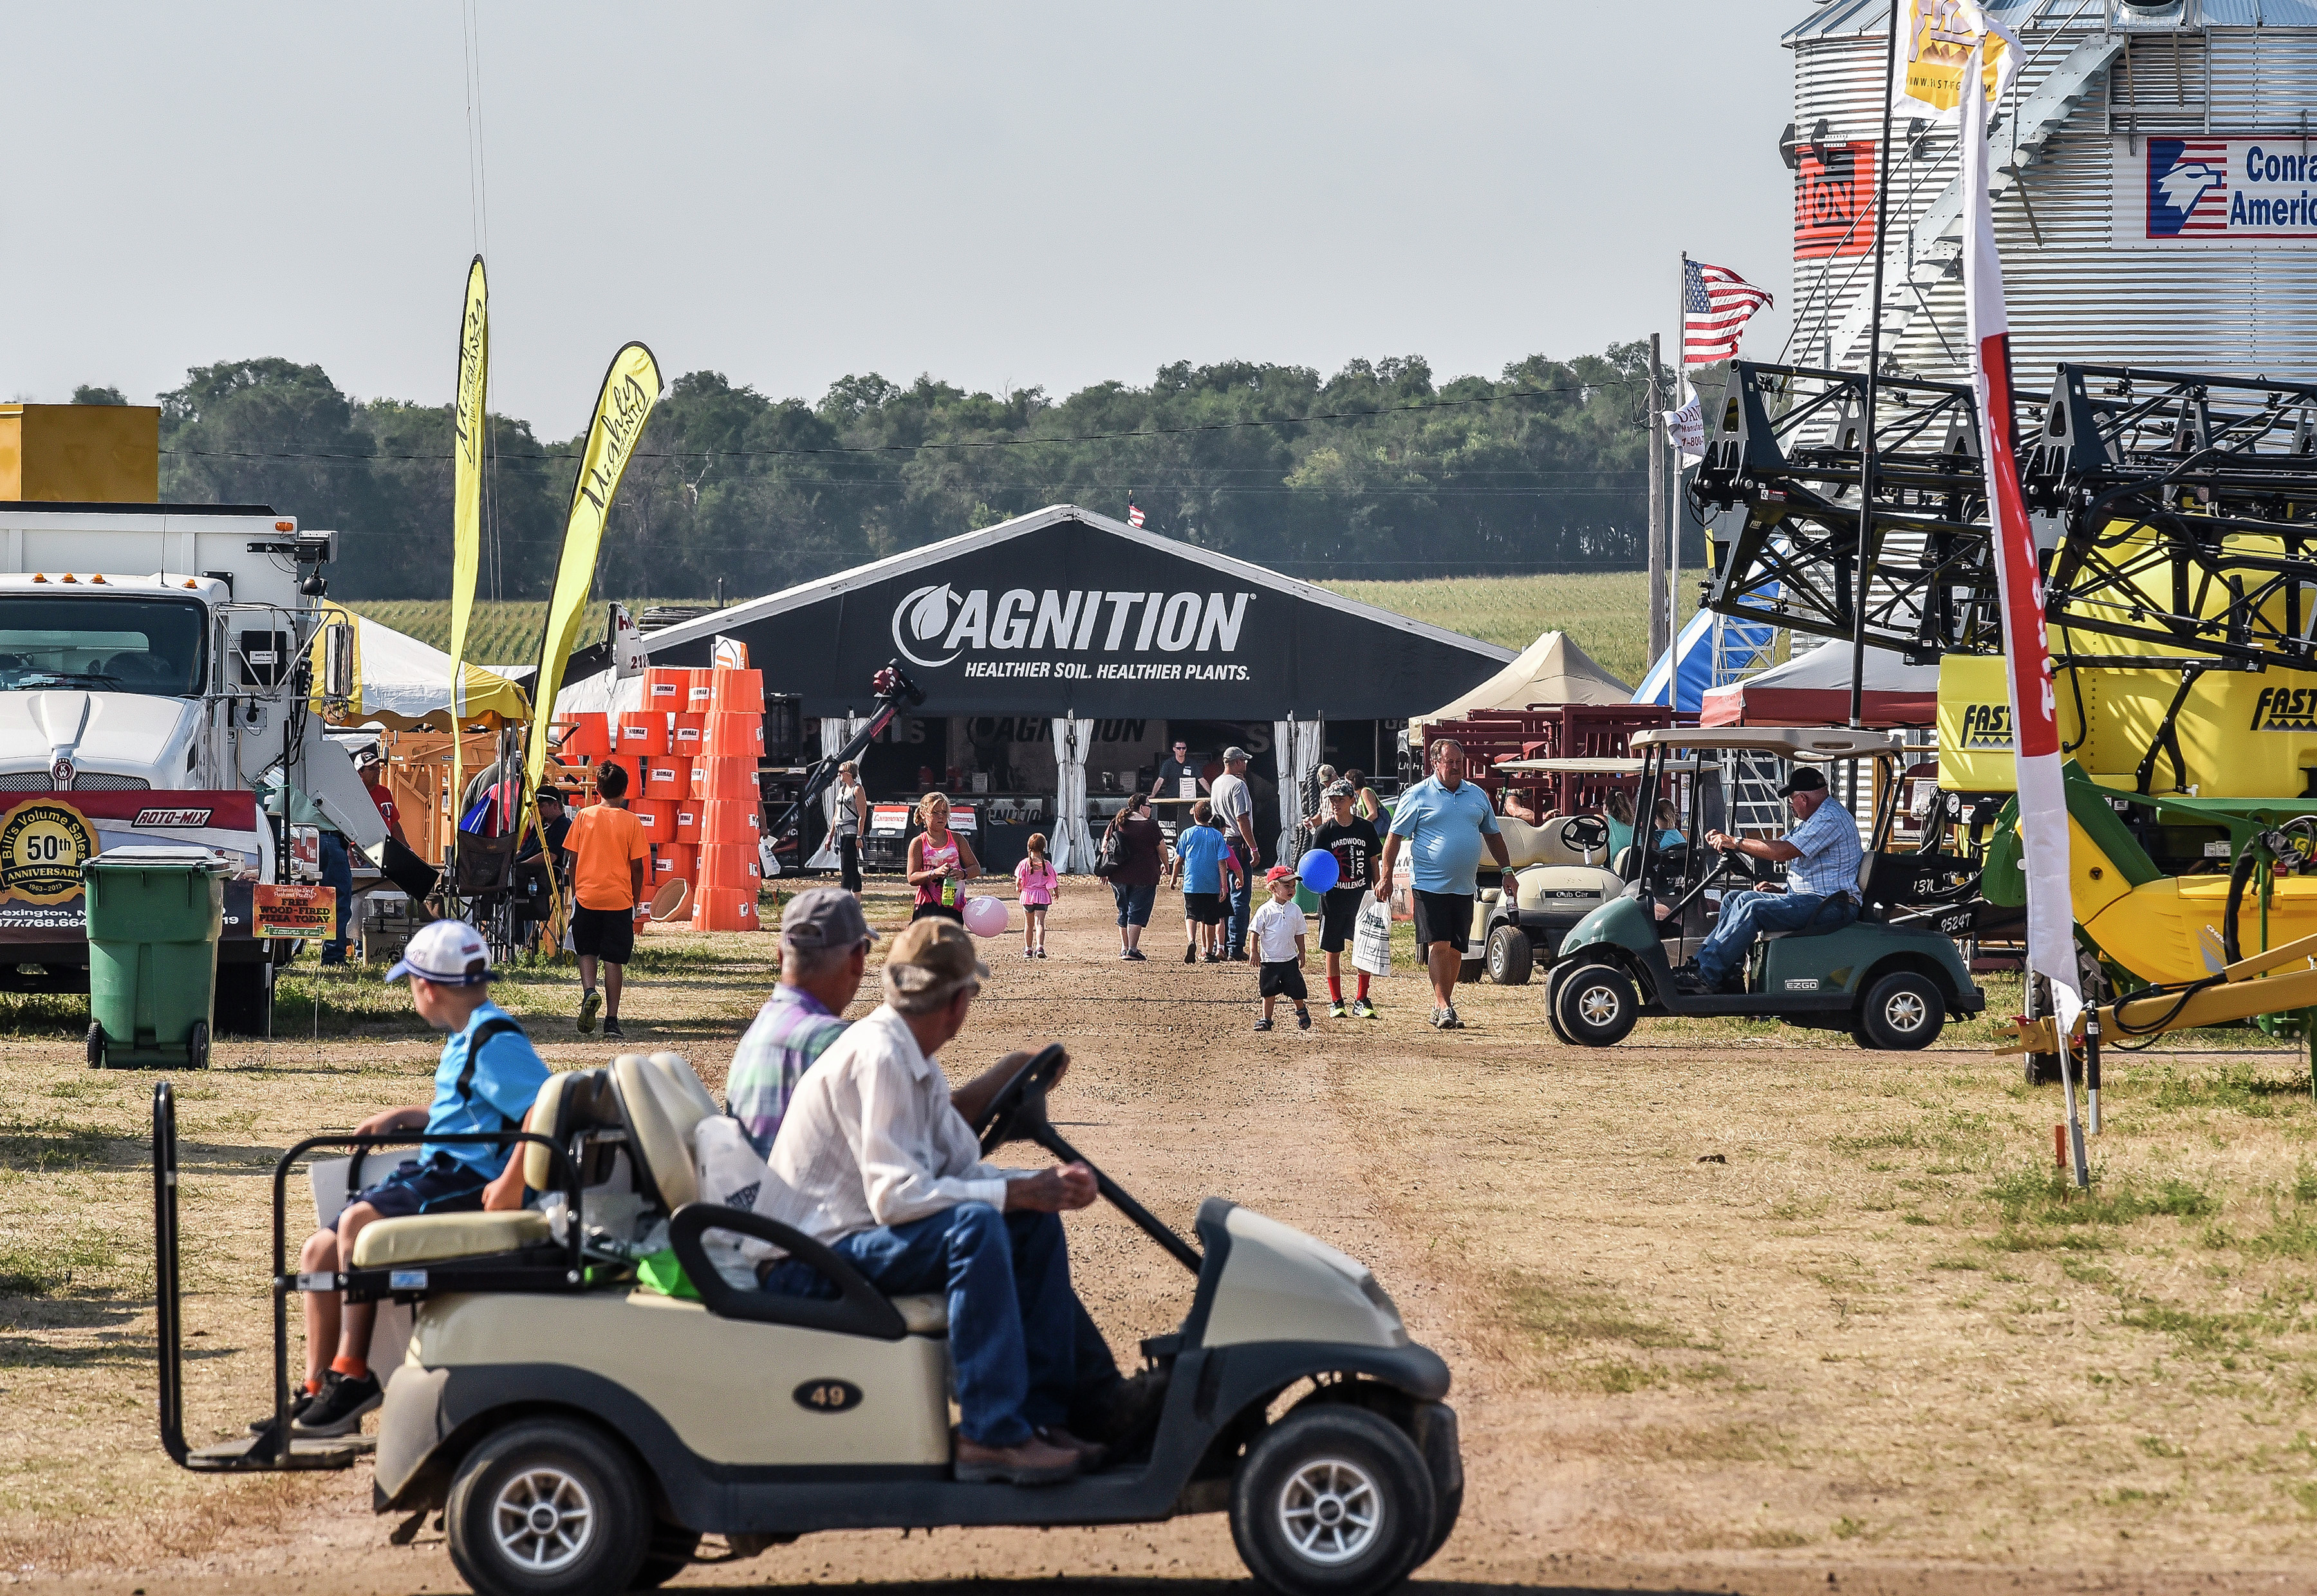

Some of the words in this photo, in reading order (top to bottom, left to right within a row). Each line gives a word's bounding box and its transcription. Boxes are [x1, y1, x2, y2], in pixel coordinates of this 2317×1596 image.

[581, 374, 646, 530] Mighty
[944, 589, 1249, 652] AGNITION
[965, 662, 1051, 678] HEALTHIER
[1054, 663, 1092, 680] SOIL.
[1097, 663, 1180, 680] HEALTHIER
[1184, 665, 1251, 681] PLANTS.
[2250, 687, 2317, 731] FAST
[136, 810, 208, 825] ROTO-MIX
[3, 826, 19, 860] Bill's
[17, 810, 68, 826] Volume
[69, 822, 86, 860] Sales
[1331, 837, 1366, 849] HARDWOOD
[27, 835, 71, 861] 50th
[1356, 849, 1364, 875] 2015
[8, 868, 81, 881] ANNIVERSARY
[0, 909, 72, 918] exington,
[259, 905, 330, 915] WOOD-FIRED
[259, 914, 291, 922] PIZZA
[295, 914, 330, 923] TODAY
[810, 1385, 846, 1407] 49
